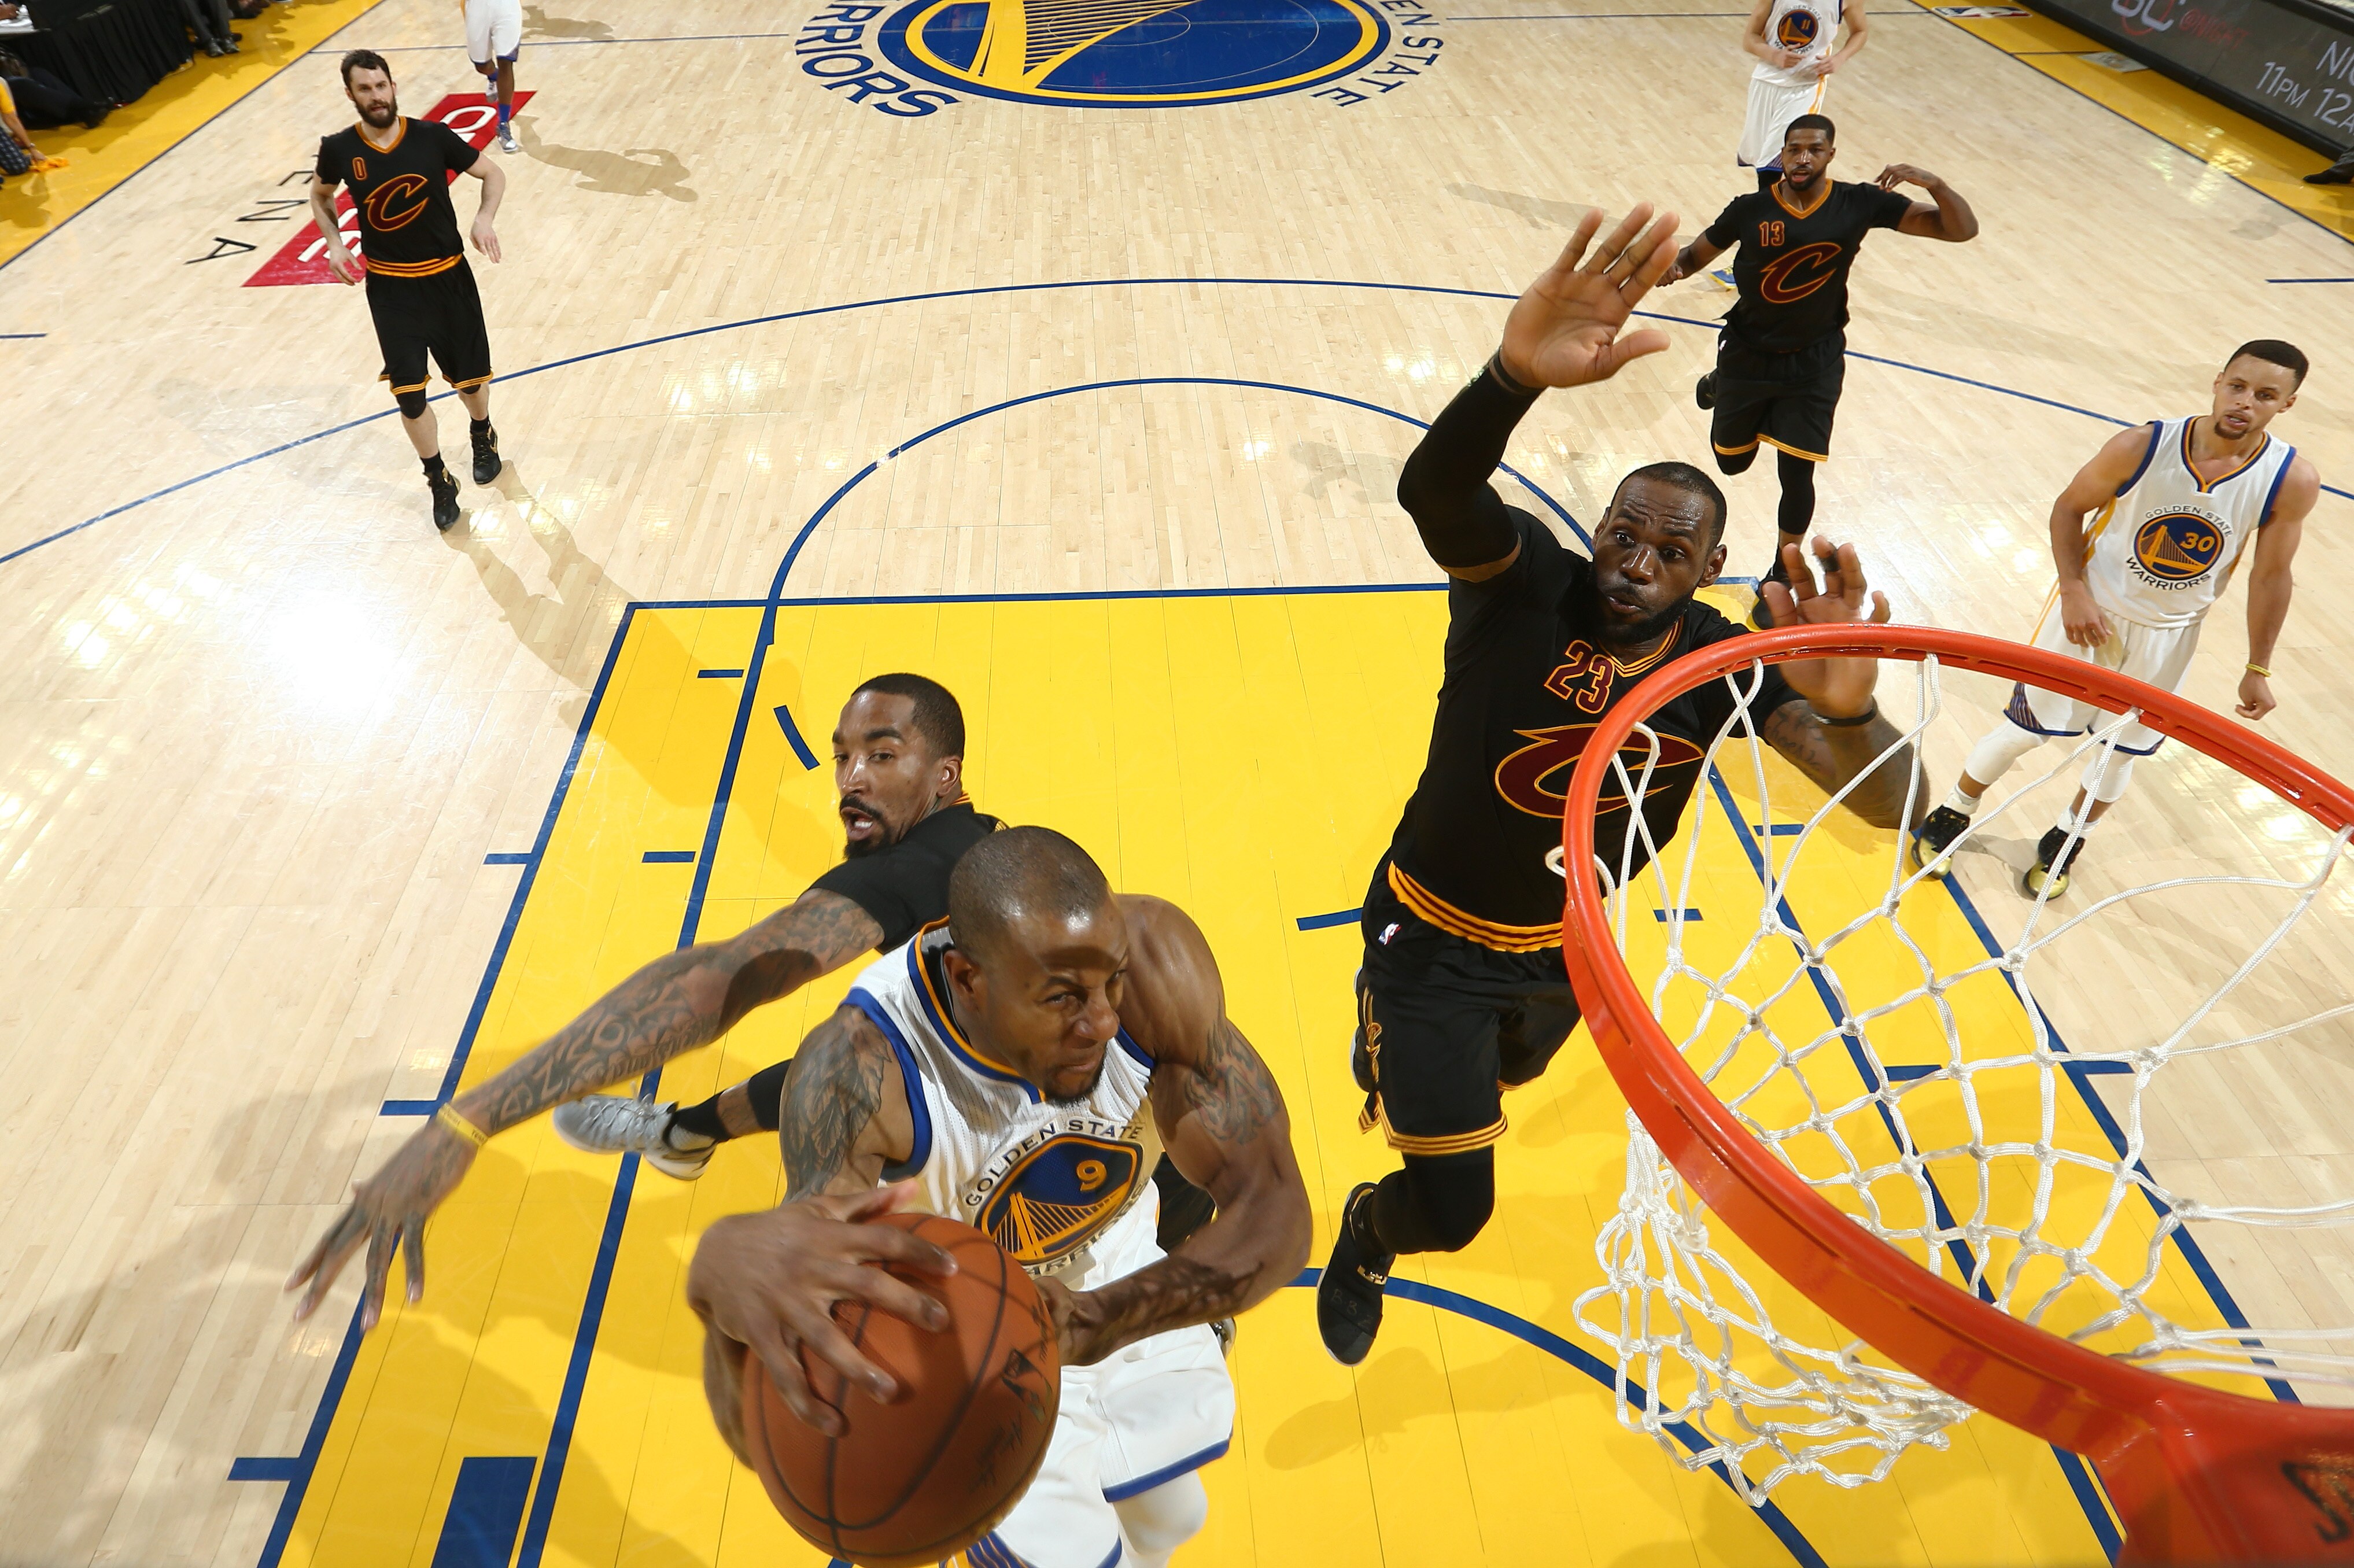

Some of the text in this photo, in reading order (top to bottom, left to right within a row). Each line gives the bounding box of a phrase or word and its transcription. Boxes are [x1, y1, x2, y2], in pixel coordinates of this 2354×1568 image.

[794, 0, 962, 117] RRIORS
[1774, 39, 1814, 54] WAORS
[1309, 36, 1444, 107] STATE
[2257, 61, 2354, 135] 11PM 12A
[352, 156, 367, 180] 0
[1759, 220, 1785, 246] 13
[2145, 505, 2234, 537] GOLDEN STATE
[2180, 532, 2215, 552] 30
[2126, 556, 2211, 591] WARRIORS
[1544, 640, 1617, 714] 23
[965, 1119, 1143, 1207] GOLDEN STATE
[1076, 1159, 1107, 1192] 9
[1023, 1182, 1146, 1275] ARRIORS
